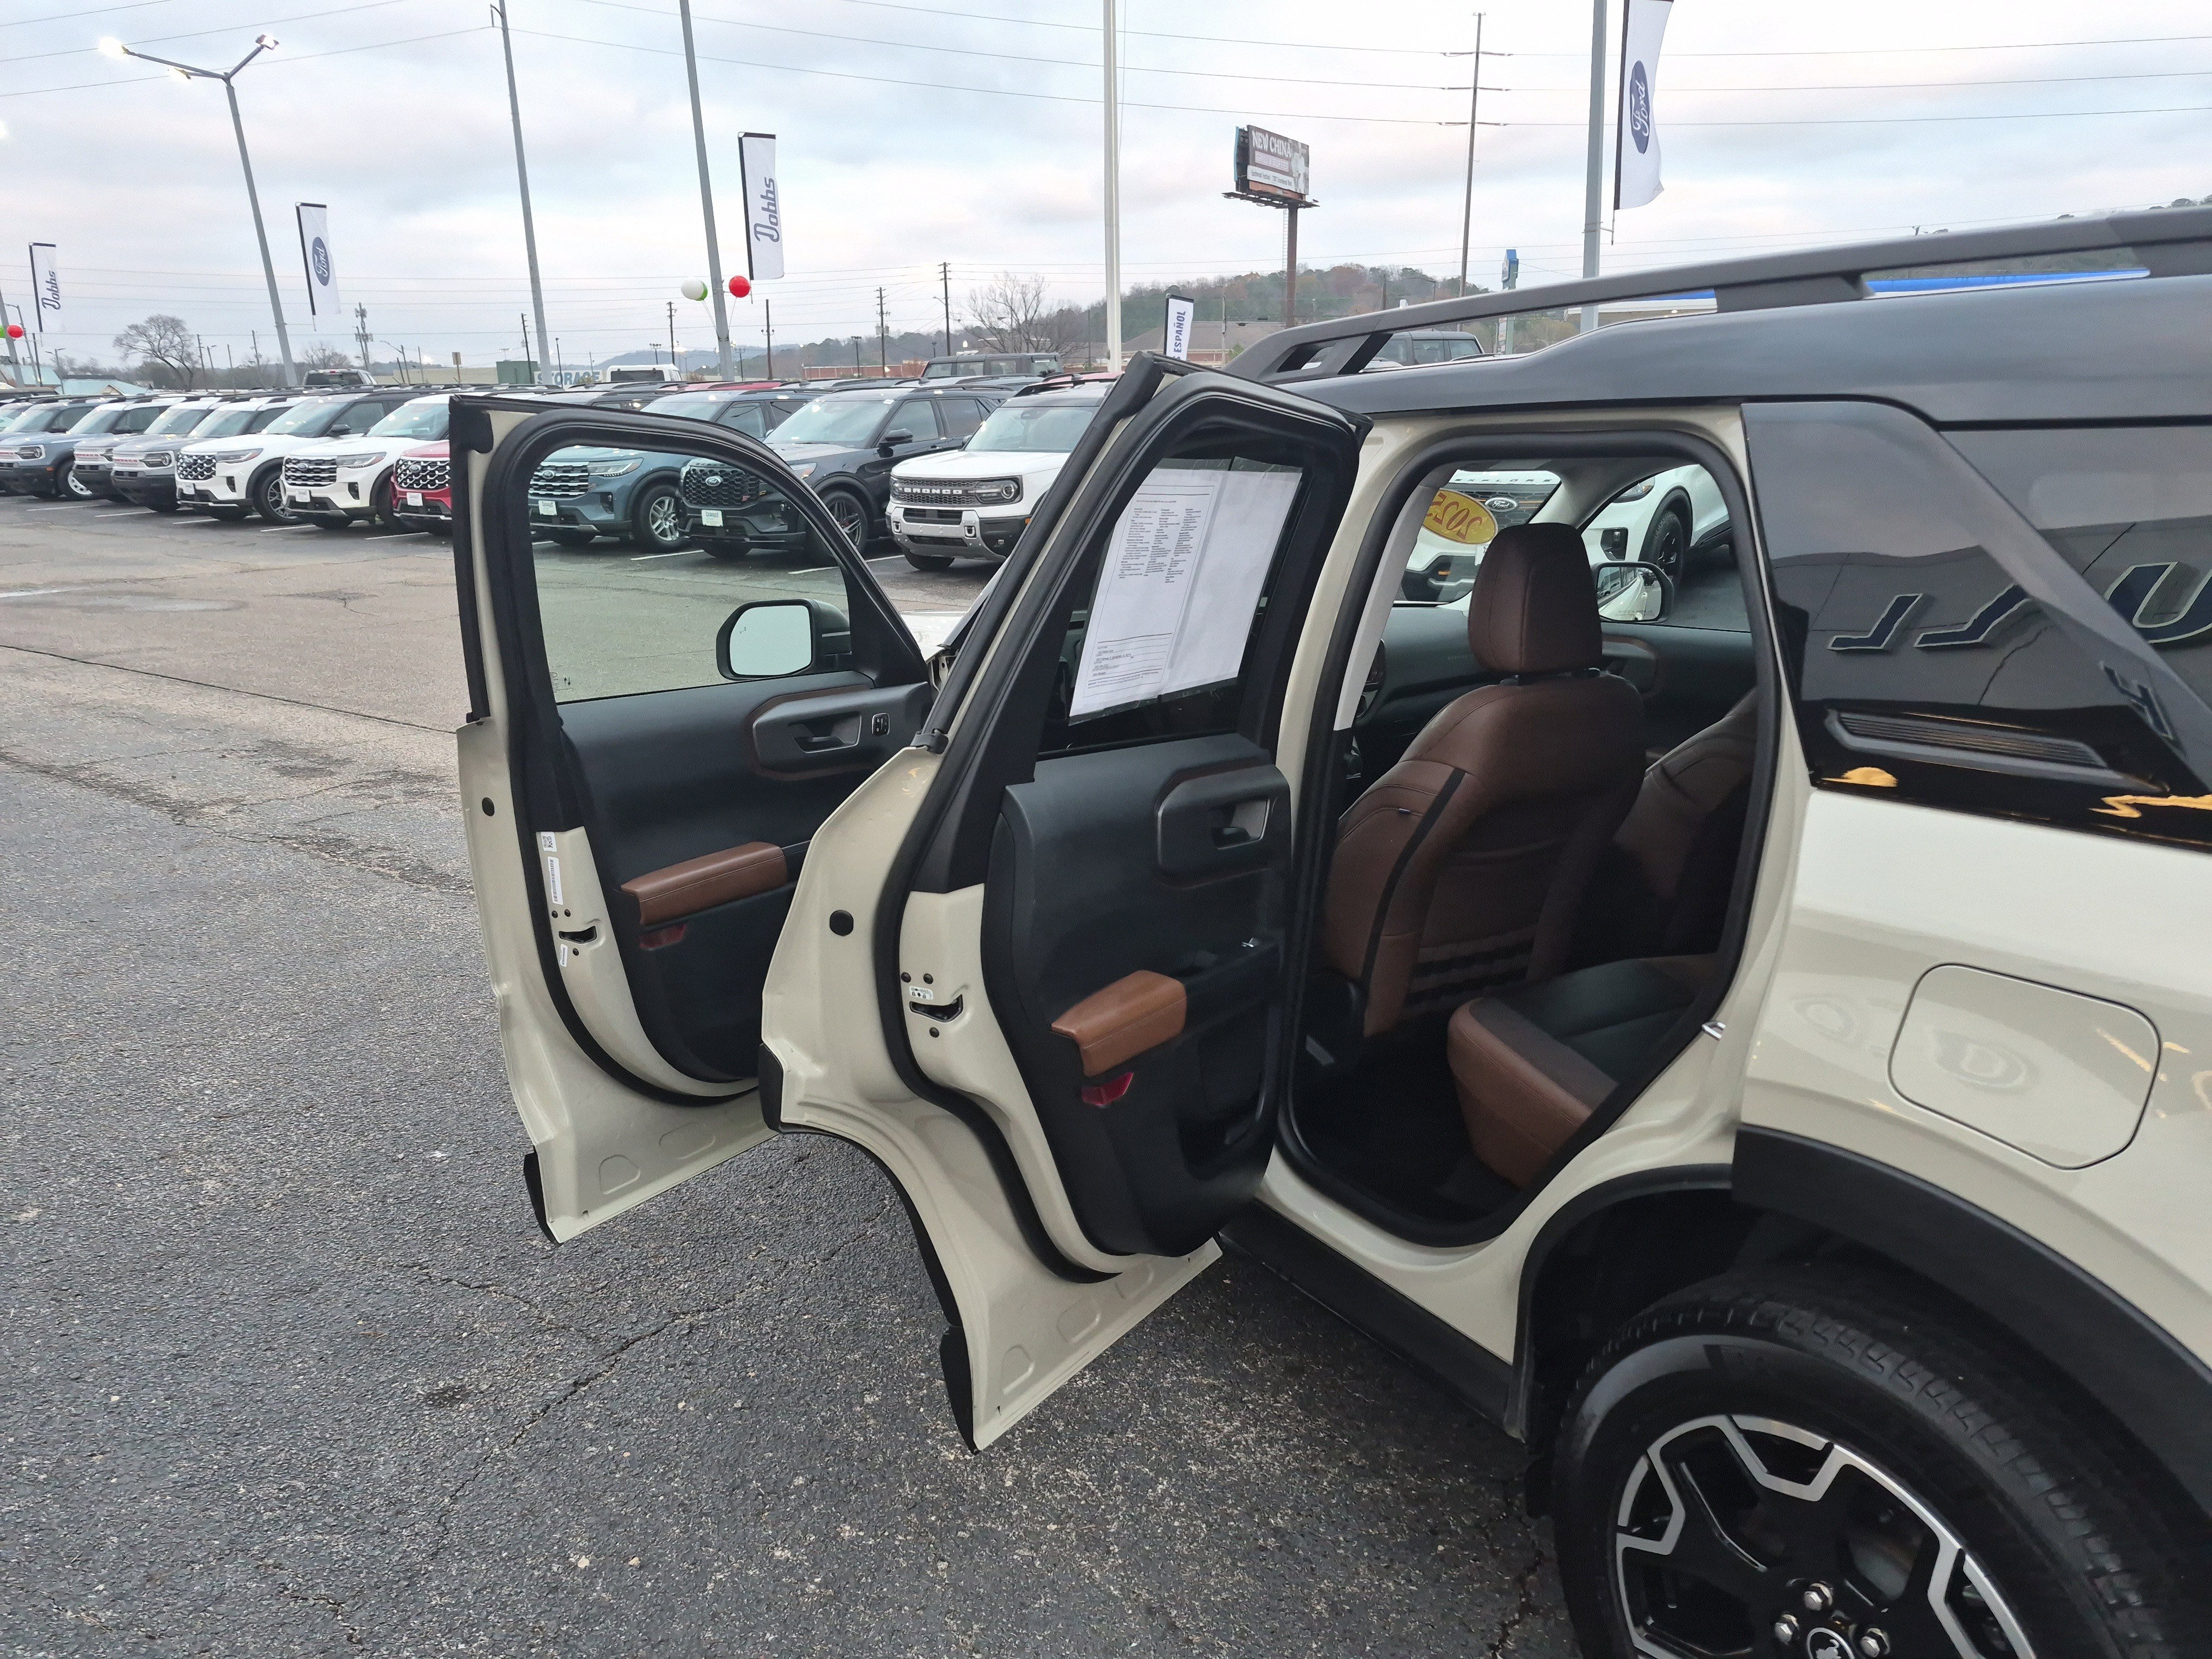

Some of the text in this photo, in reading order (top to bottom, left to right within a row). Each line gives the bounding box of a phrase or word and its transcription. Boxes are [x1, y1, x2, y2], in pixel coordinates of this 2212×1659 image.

[1631, 80, 1650, 137] Ford
[1252, 130, 1291, 158] NEW CHINA
[754, 177, 780, 243] Dobbs
[314, 247, 329, 277] Ford
[41, 270, 61, 310] Dobbs
[1173, 311, 1186, 353] ESPAÑOL
